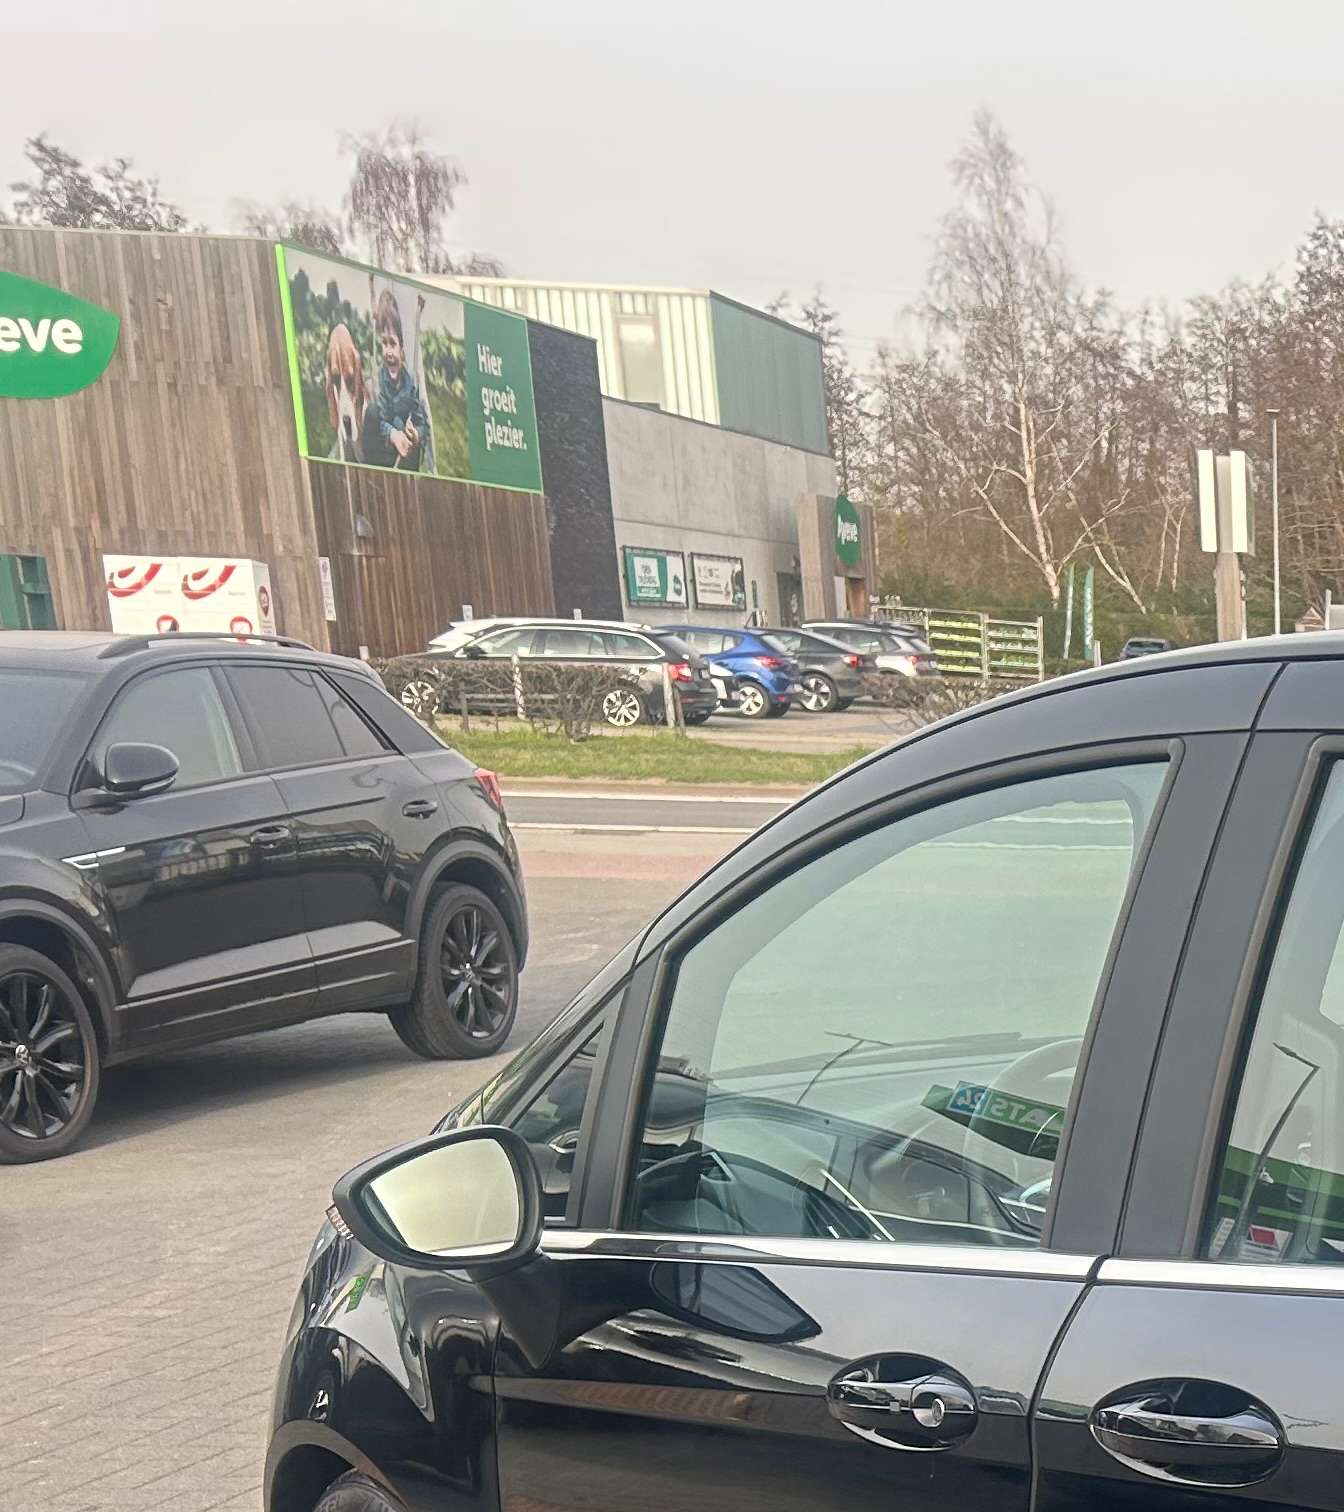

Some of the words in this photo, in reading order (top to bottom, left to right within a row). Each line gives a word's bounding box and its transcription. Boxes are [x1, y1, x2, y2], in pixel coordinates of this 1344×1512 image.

[477, 343, 502, 376] Hier
[481, 385, 517, 416] groeit
[485, 416, 527, 450] plezier.
